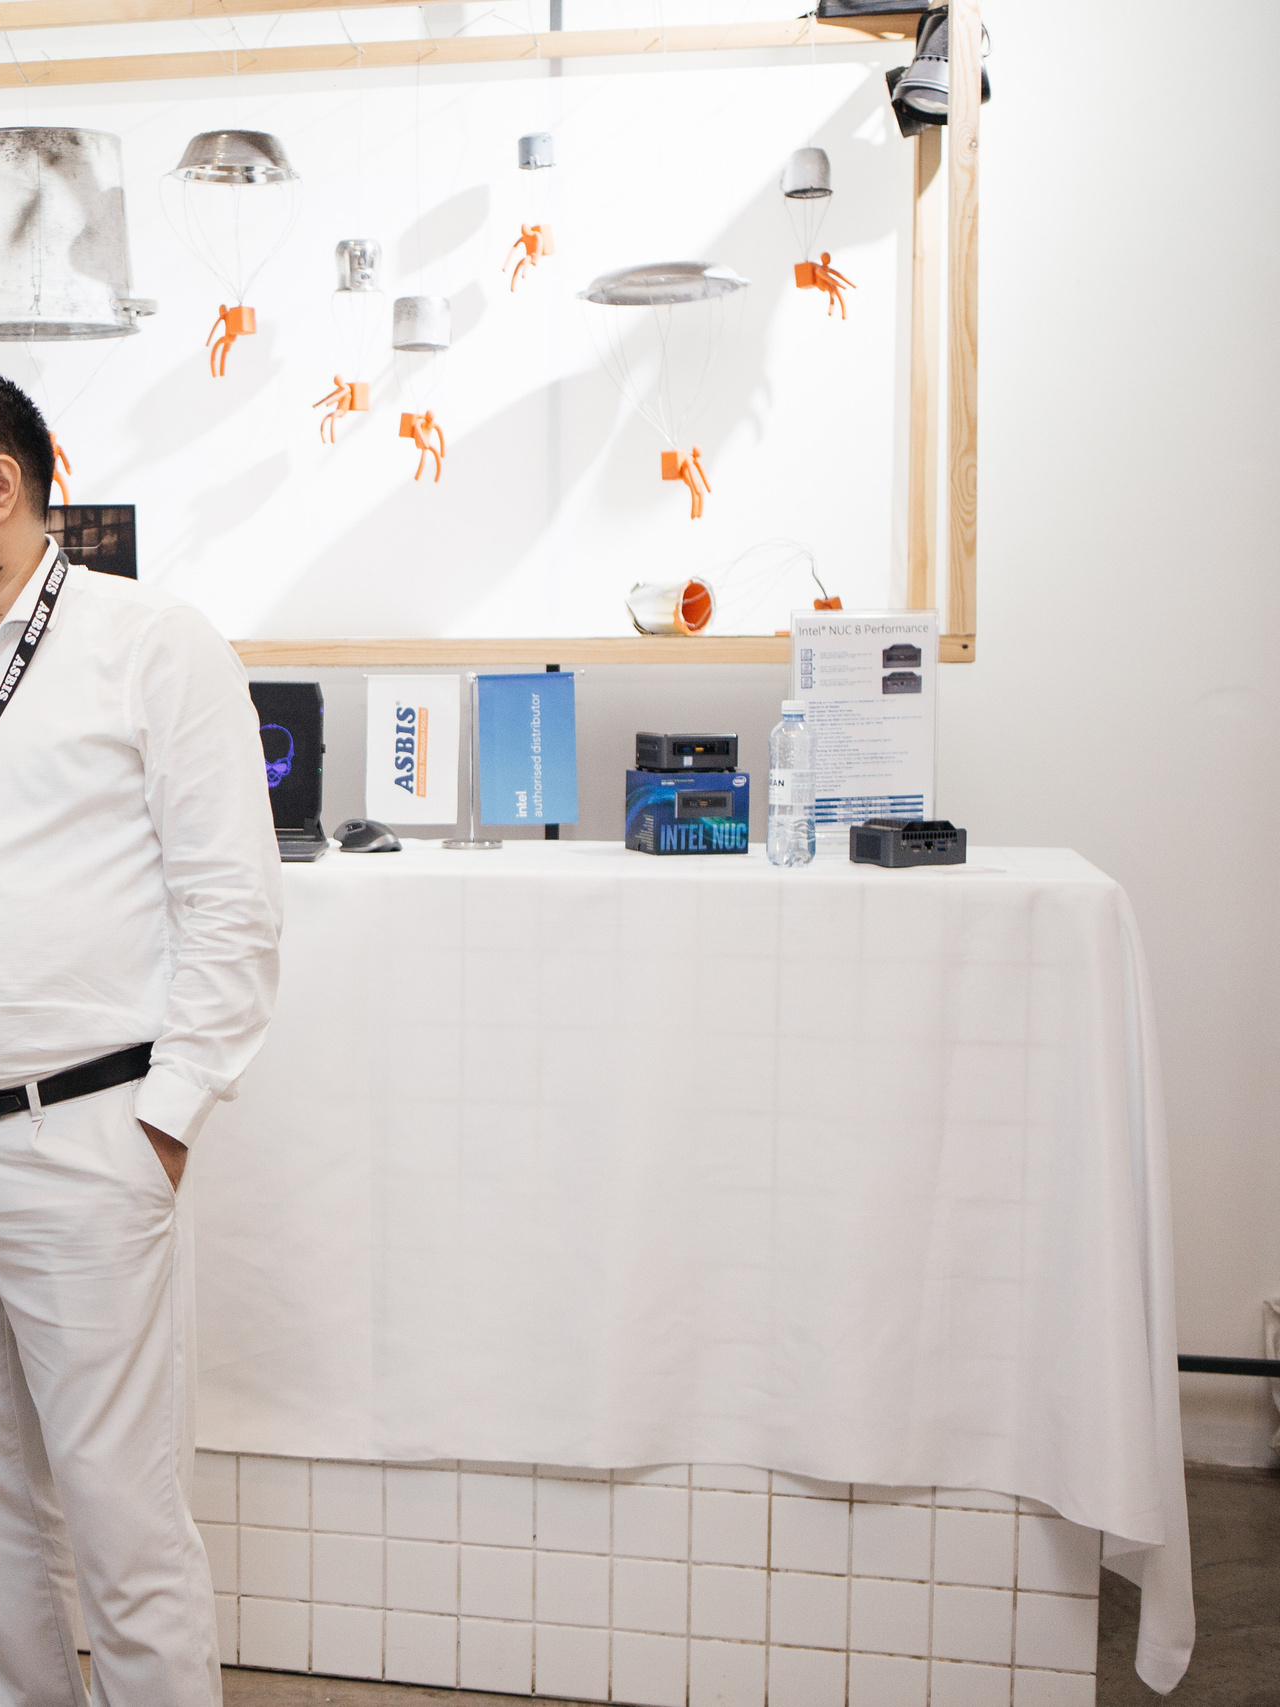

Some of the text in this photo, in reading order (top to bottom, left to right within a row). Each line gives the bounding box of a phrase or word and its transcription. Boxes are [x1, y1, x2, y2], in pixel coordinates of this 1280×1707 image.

[46, 560, 66, 595] ASBIS
[25, 600, 50, 645] ASBIS
[830, 625, 852, 635] NUC
[855, 625, 862, 635] 8
[865, 623, 929, 634] Performance
[394, 707, 416, 794] ASBIS
[530, 693, 543, 818] authorised distributor
[516, 791, 527, 818] intel
[660, 824, 707, 851] INTEL
[712, 823, 748, 850] NUC
